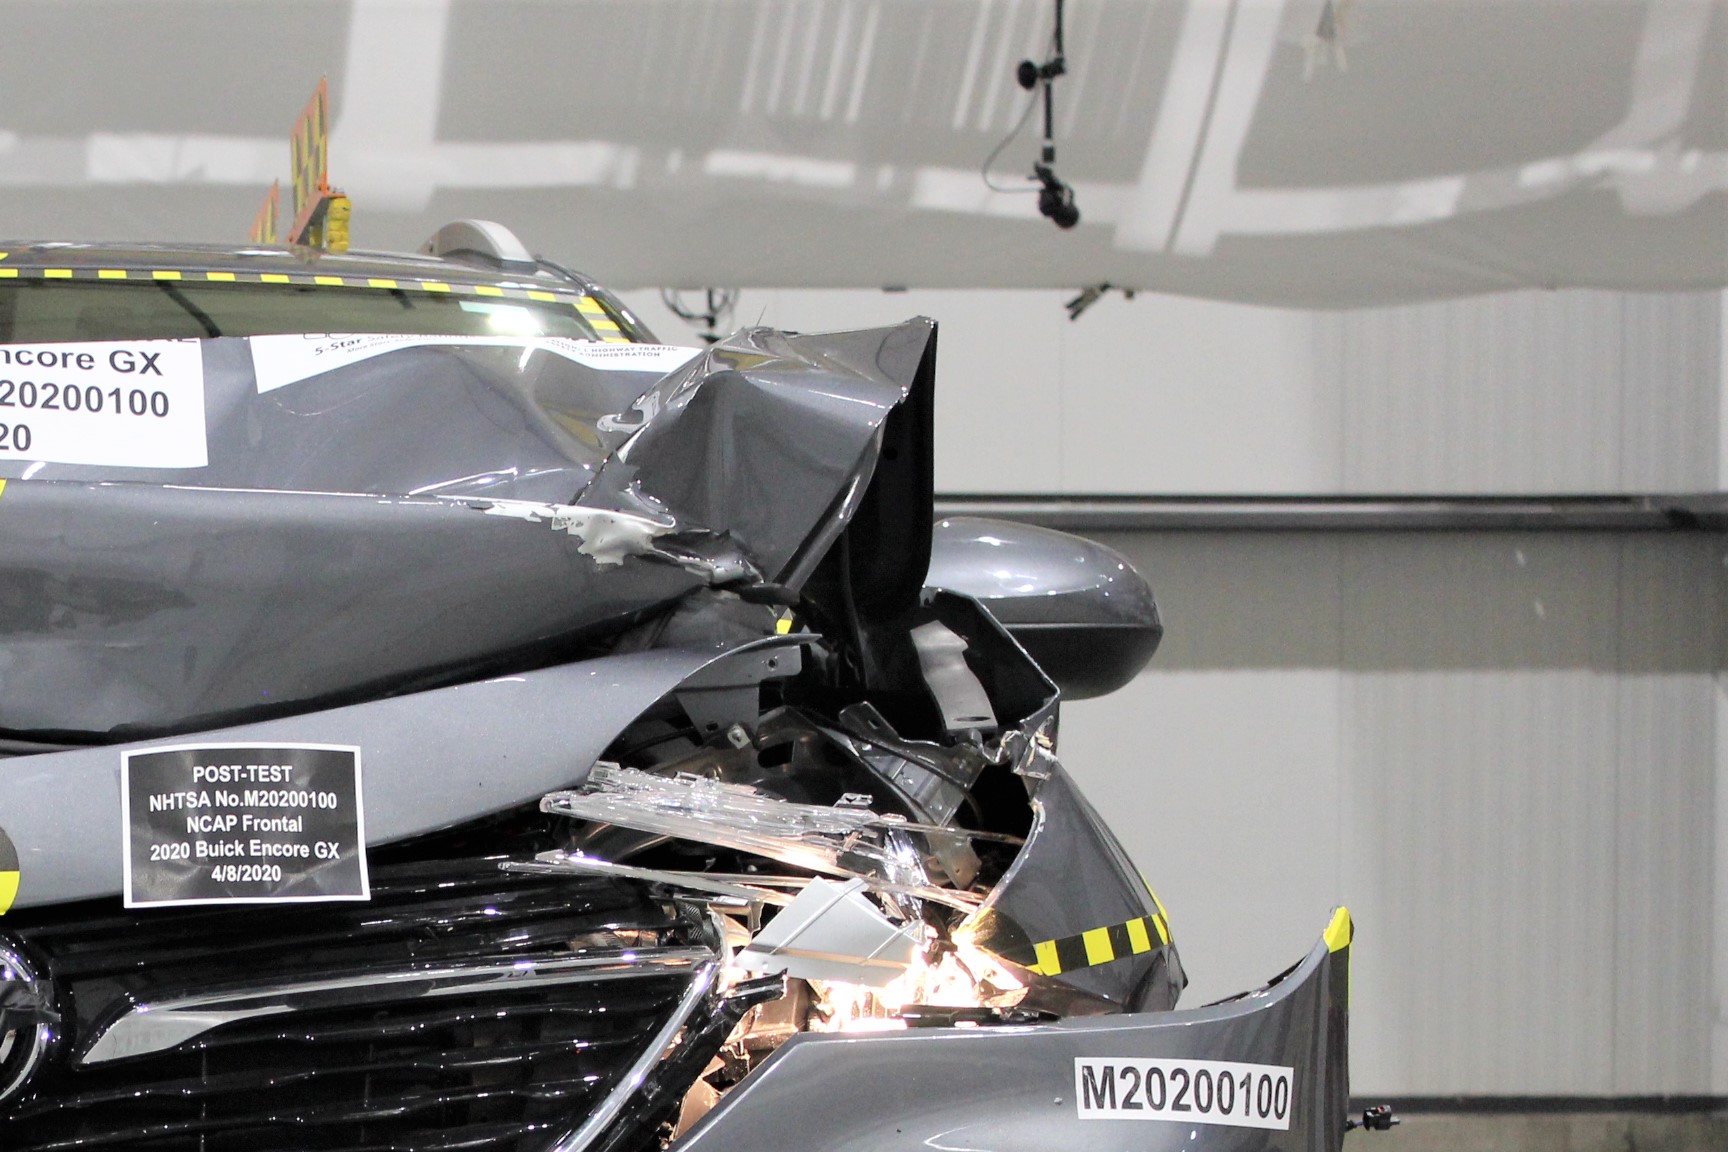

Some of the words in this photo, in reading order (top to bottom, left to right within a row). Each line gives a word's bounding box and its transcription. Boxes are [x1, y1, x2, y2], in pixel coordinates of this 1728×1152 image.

[315, 338, 363, 356] 5-Star
[108, 349, 164, 376] GX
[193, 765, 293, 784] POST-TEST
[149, 791, 211, 812] NHTSA
[186, 815, 238, 834] NCAP
[242, 814, 303, 833] Frontal
[150, 842, 190, 861] 2020
[195, 839, 245, 858] Buick
[249, 839, 310, 858] Encore
[314, 841, 340, 860] GX
[211, 864, 282, 883] 4/8/2020
[1081, 1065, 1289, 1121] M20200100
